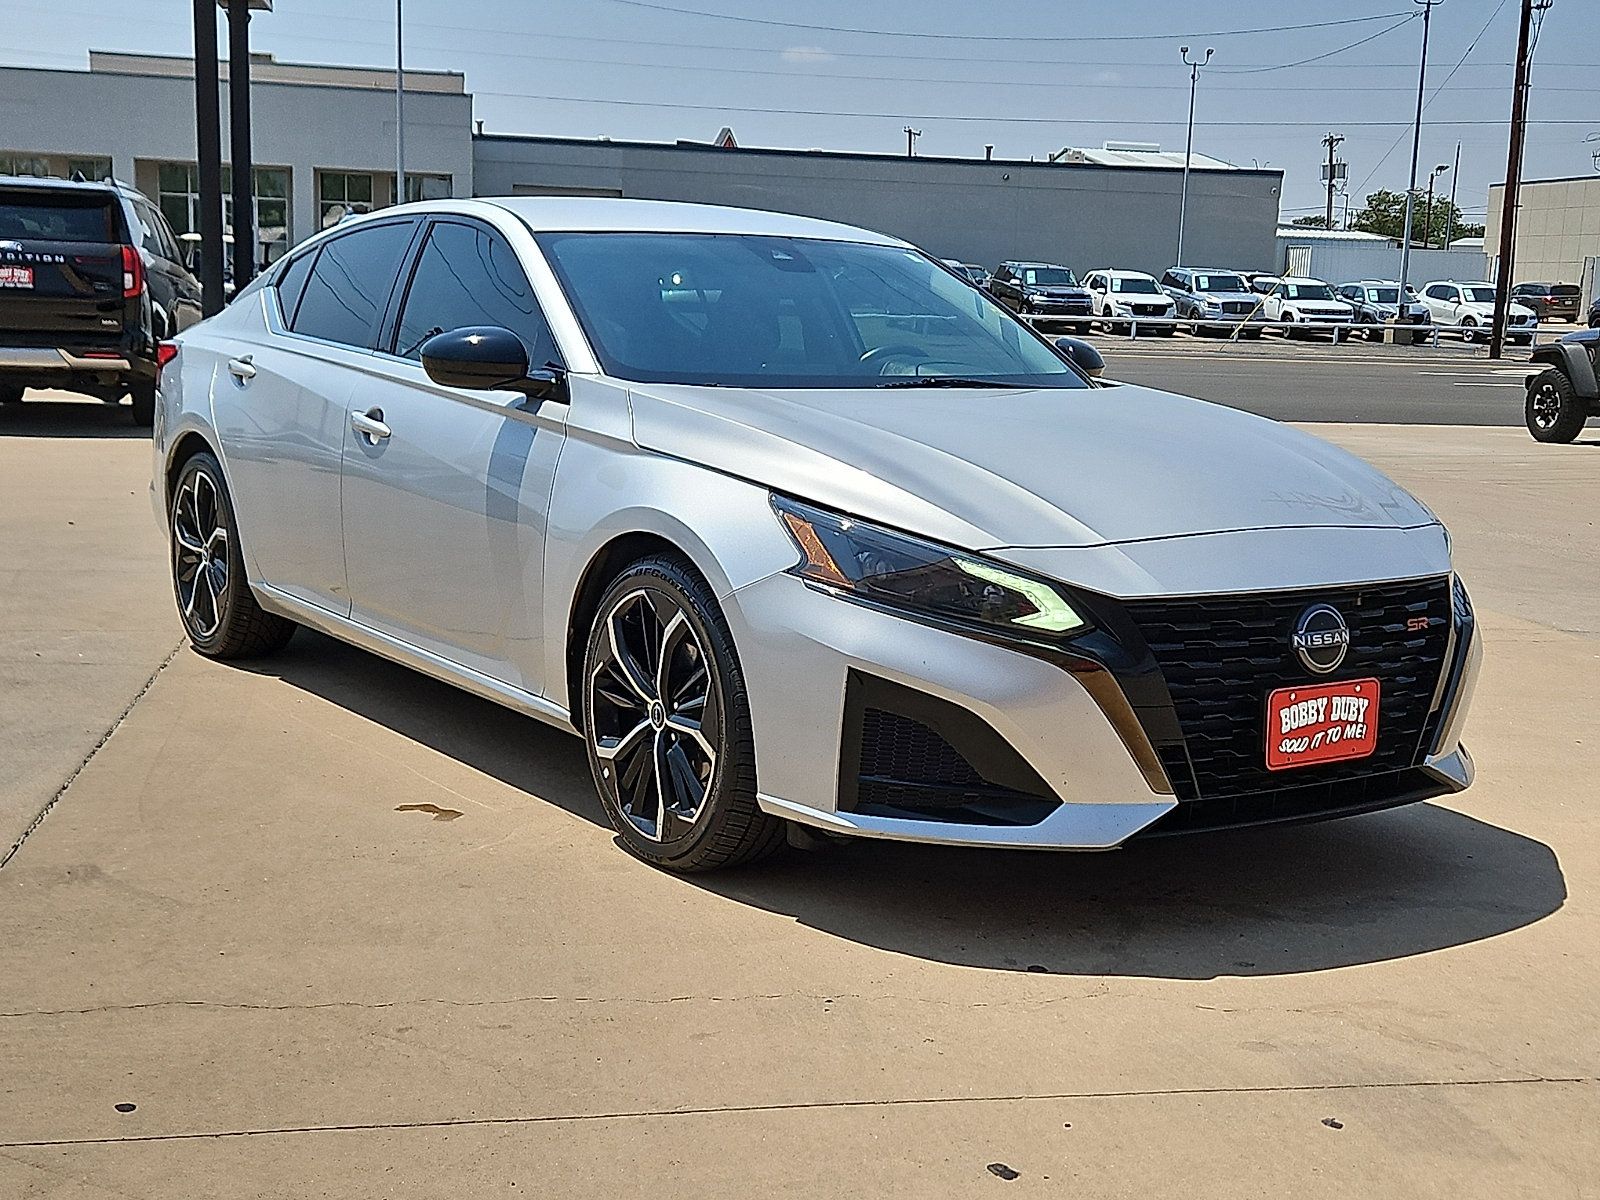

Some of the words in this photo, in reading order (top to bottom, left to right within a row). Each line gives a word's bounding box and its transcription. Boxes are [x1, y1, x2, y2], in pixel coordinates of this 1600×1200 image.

[1407, 616, 1429, 632] SR
[1294, 630, 1350, 647] NISSAN
[1280, 697, 1328, 734] BOBBY
[1330, 696, 1369, 723] DUBY
[1278, 736, 1310, 753] SOLD
[1310, 732, 1325, 750] IT
[1325, 725, 1342, 745] TO
[1343, 723, 1367, 740] ME!
